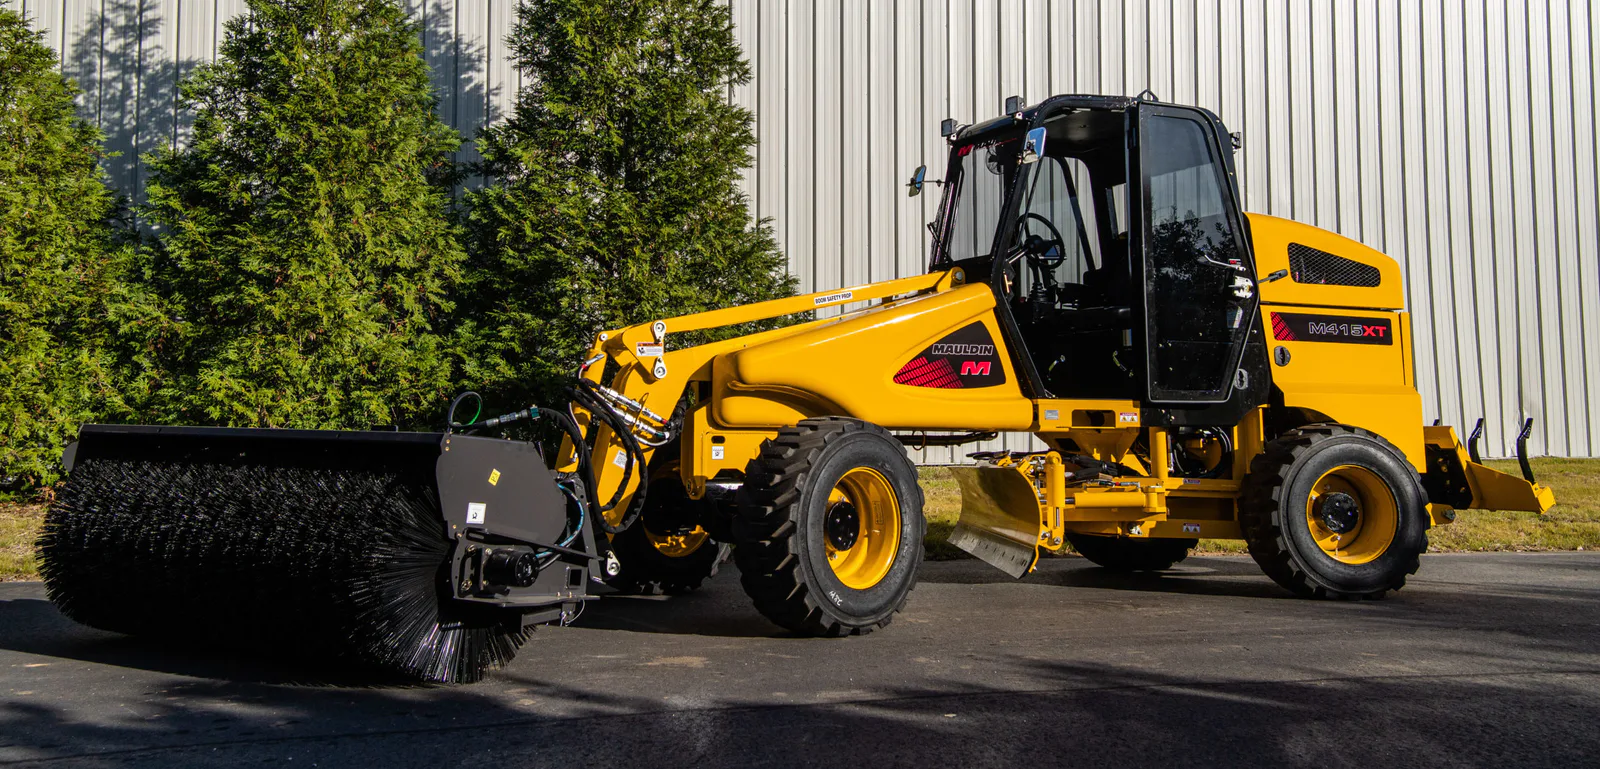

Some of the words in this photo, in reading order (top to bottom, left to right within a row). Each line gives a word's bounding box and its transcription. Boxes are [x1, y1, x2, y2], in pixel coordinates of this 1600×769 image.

[827, 294, 840, 302] SAFETY
[1308, 321, 1387, 338] M415XT
[932, 343, 994, 356] MAULDIN
[960, 361, 991, 375] M
